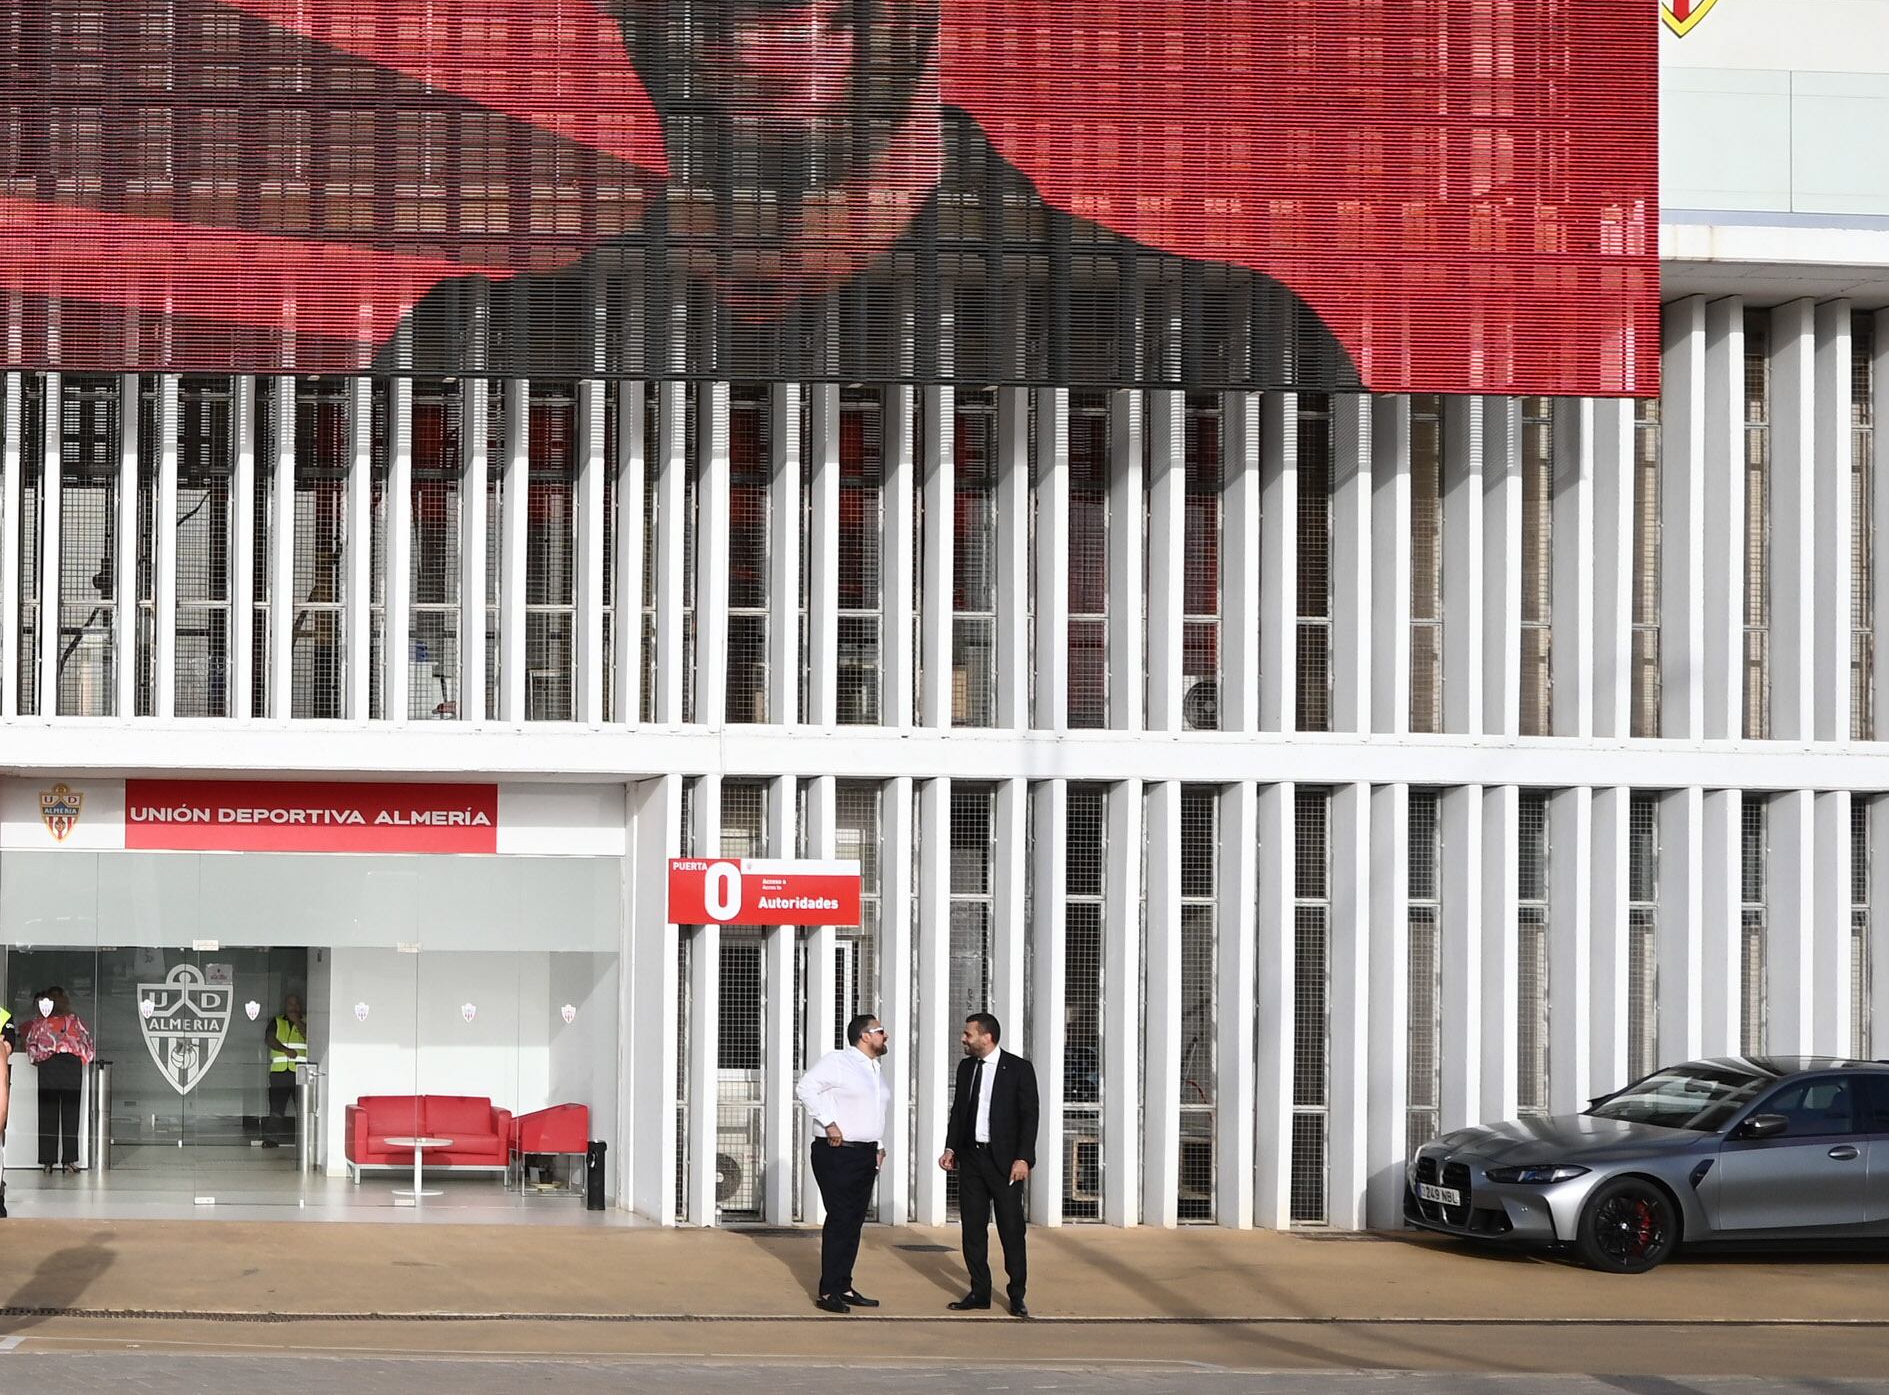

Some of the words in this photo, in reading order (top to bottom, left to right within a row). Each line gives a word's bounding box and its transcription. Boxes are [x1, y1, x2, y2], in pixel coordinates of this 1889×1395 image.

[44, 796, 54, 804] U
[67, 796, 78, 804] D
[129, 803, 210, 823] UNIÓN
[217, 808, 367, 825] DEPORTIVA
[374, 807, 492, 826] ALMERÍA
[672, 861, 708, 871] PUERTA
[704, 861, 742, 921] 0
[758, 896, 839, 910] Autoridades
[201, 993, 221, 1008] D
[149, 1018, 220, 1031] ALMERIA
